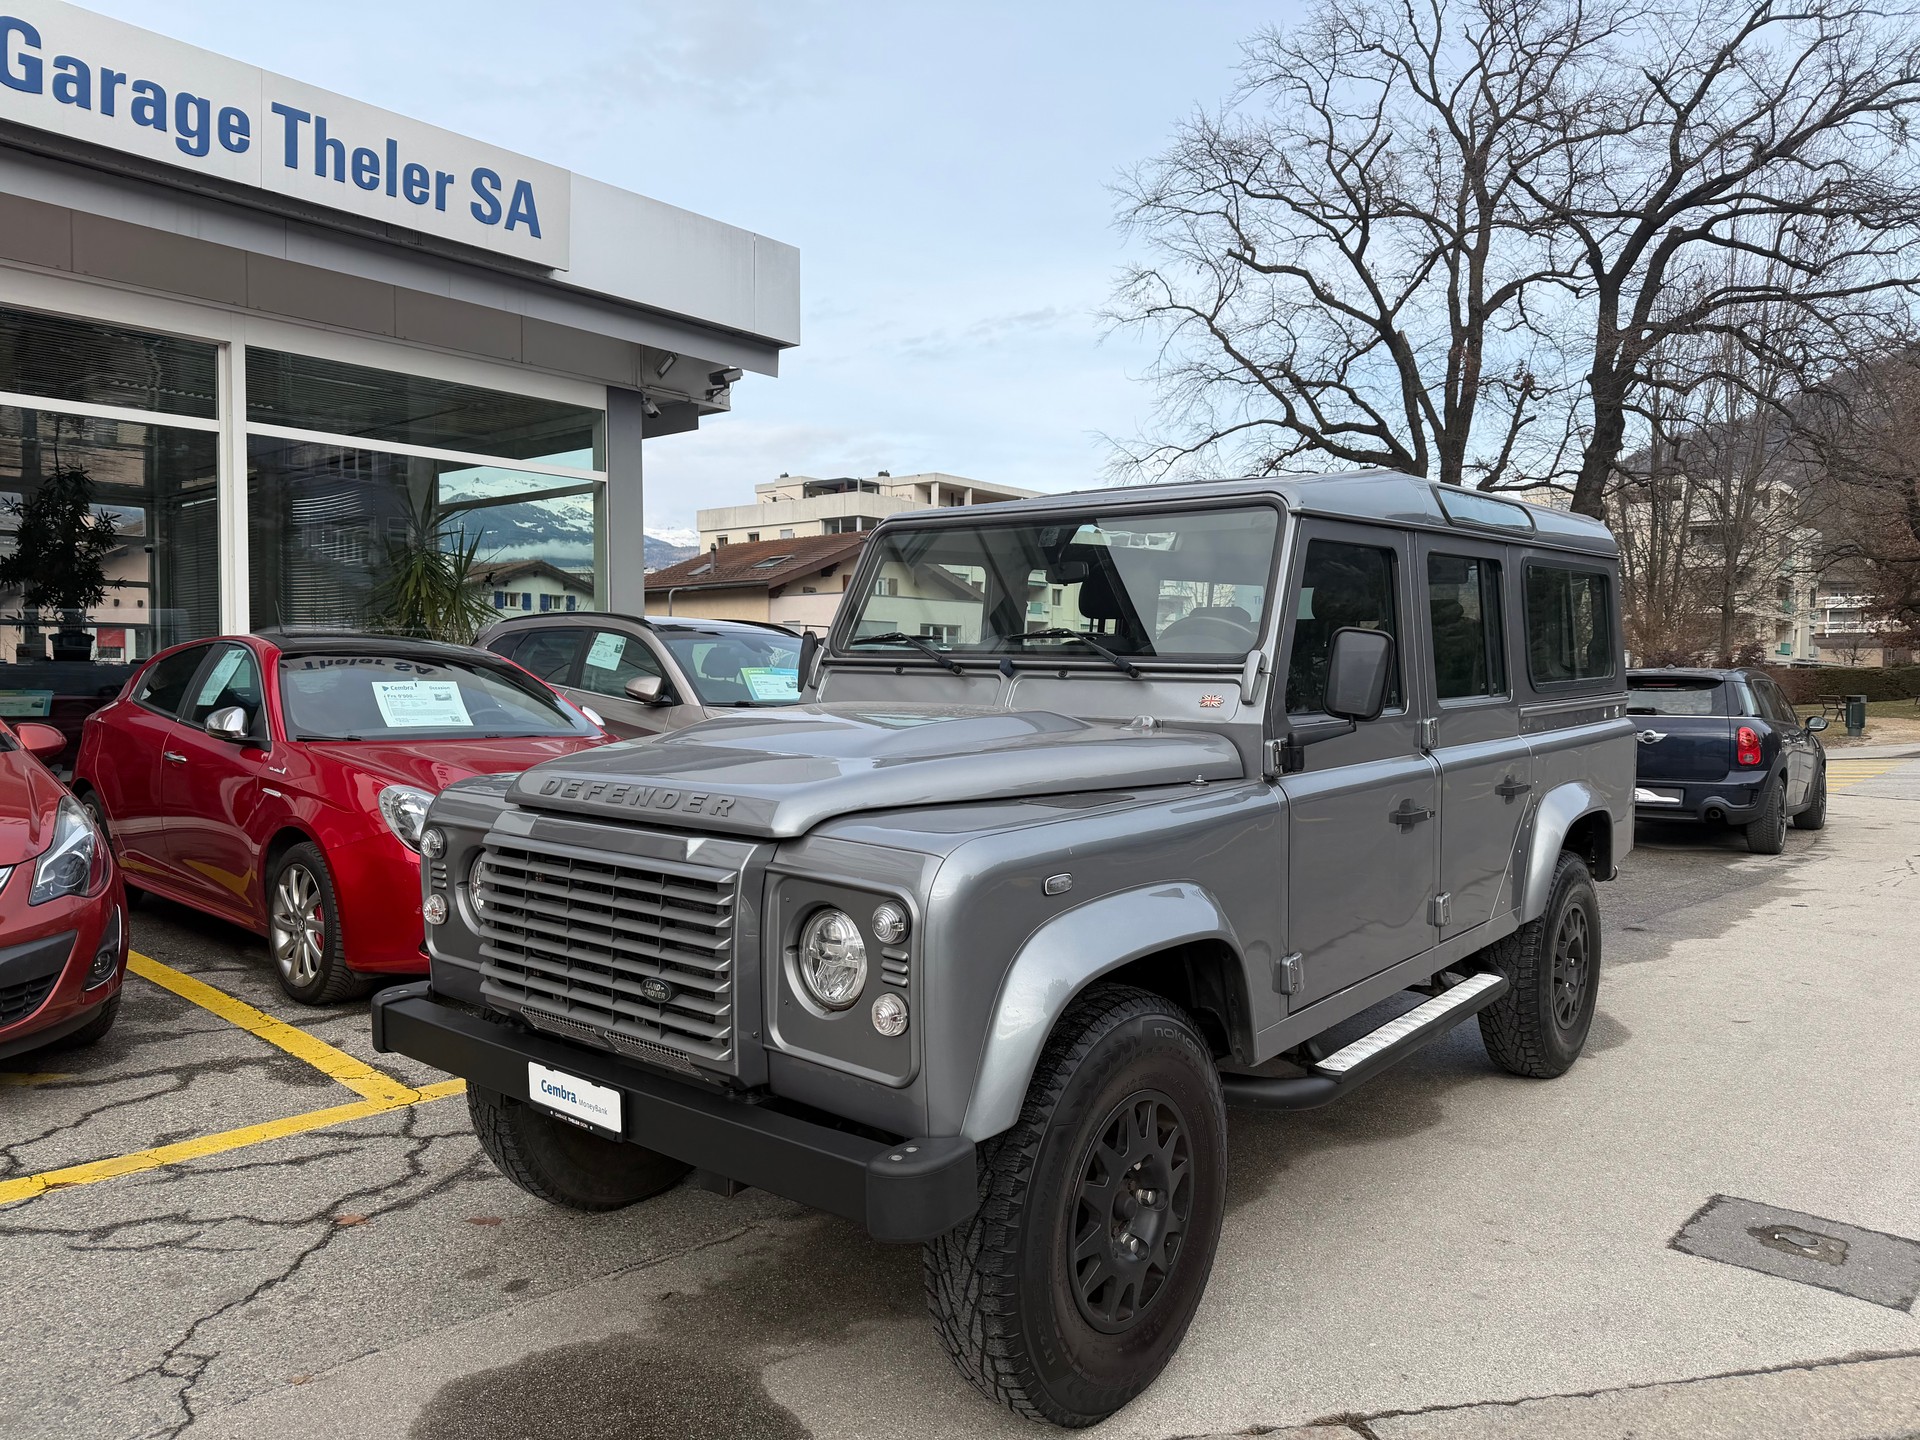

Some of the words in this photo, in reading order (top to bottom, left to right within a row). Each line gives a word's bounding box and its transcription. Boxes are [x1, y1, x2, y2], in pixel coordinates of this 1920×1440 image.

[0, 16, 251, 157] Garage
[271, 102, 455, 212] Theler
[470, 167, 542, 239] SA
[540, 777, 736, 817] DEFENDER
[645, 981, 661, 991] LAND
[647, 989, 666, 1000] ROVER
[1153, 1027, 1201, 1059] nokian
[541, 1079, 577, 1104] Cembra
[578, 1099, 608, 1116] MoneyBank
